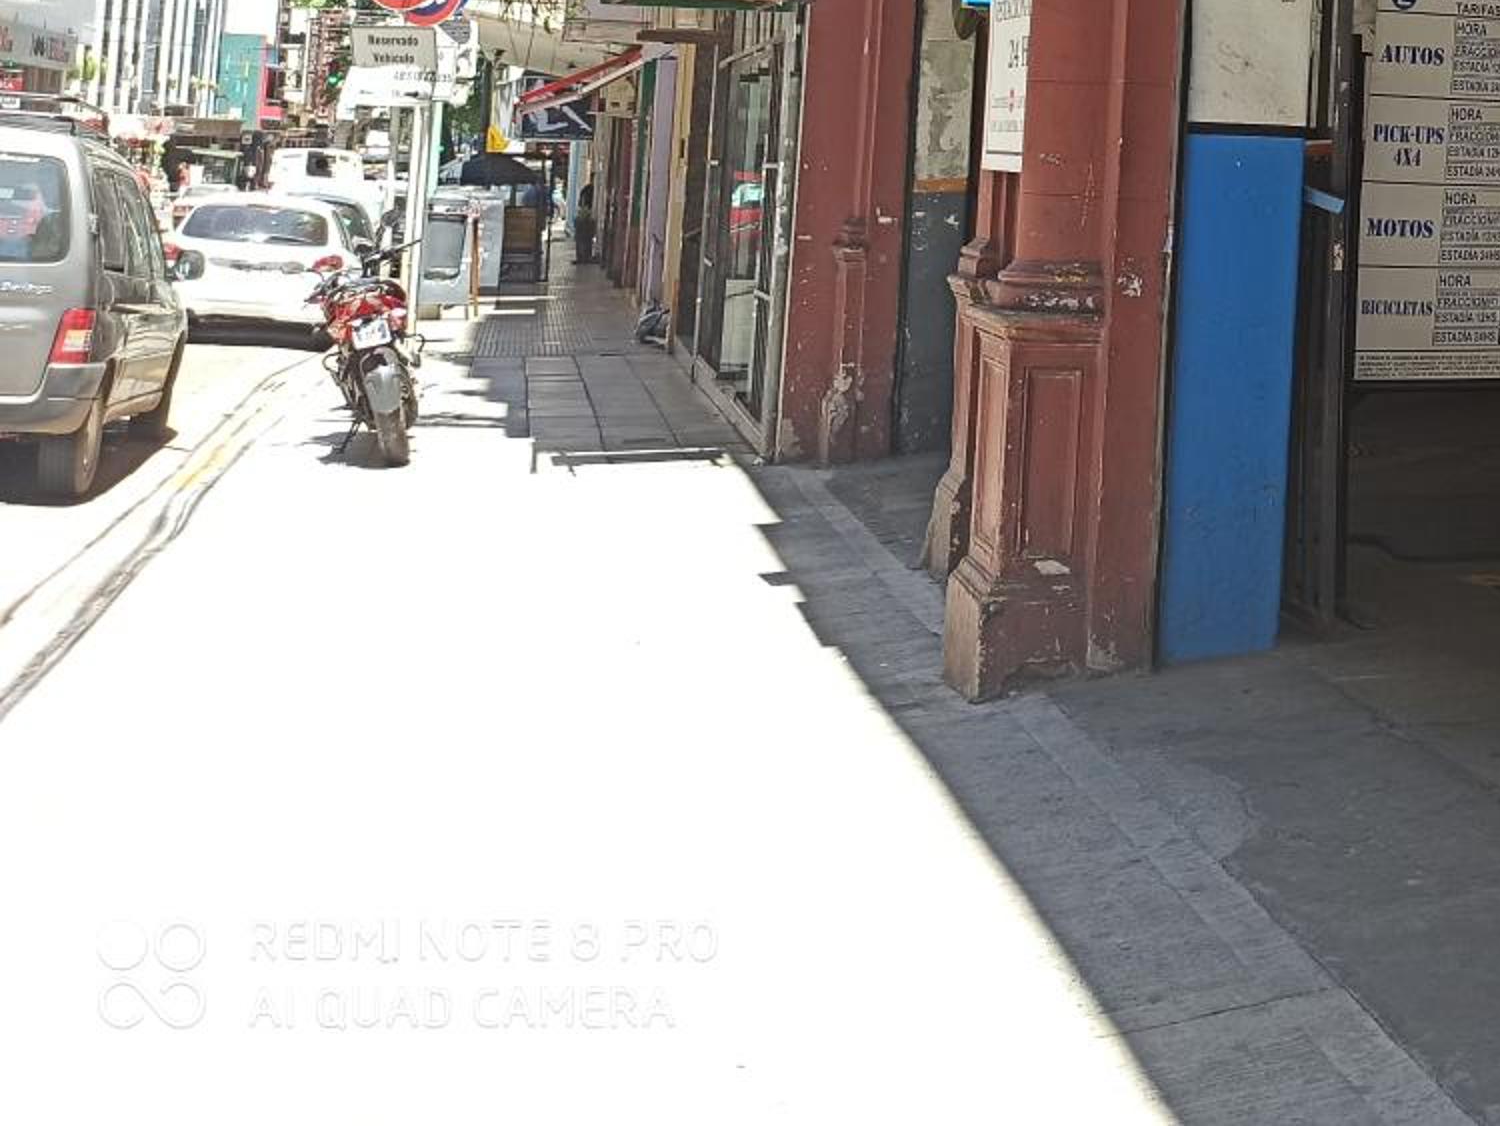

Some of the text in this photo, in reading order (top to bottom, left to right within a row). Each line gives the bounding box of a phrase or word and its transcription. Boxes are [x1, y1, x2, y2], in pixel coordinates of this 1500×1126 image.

[1456, 2, 1500, 16] TARIFAS
[1457, 23, 1487, 37] HORA
[1380, 45, 1445, 67] AUTOS
[1452, 108, 1483, 121] HORA
[1373, 125, 1445, 144] PICK-UPS
[1445, 191, 1477, 205] HORA
[1366, 218, 1434, 238] MOTOS
[1439, 273, 1472, 287] HORA
[1361, 300, 1433, 315] BICICLETAS
